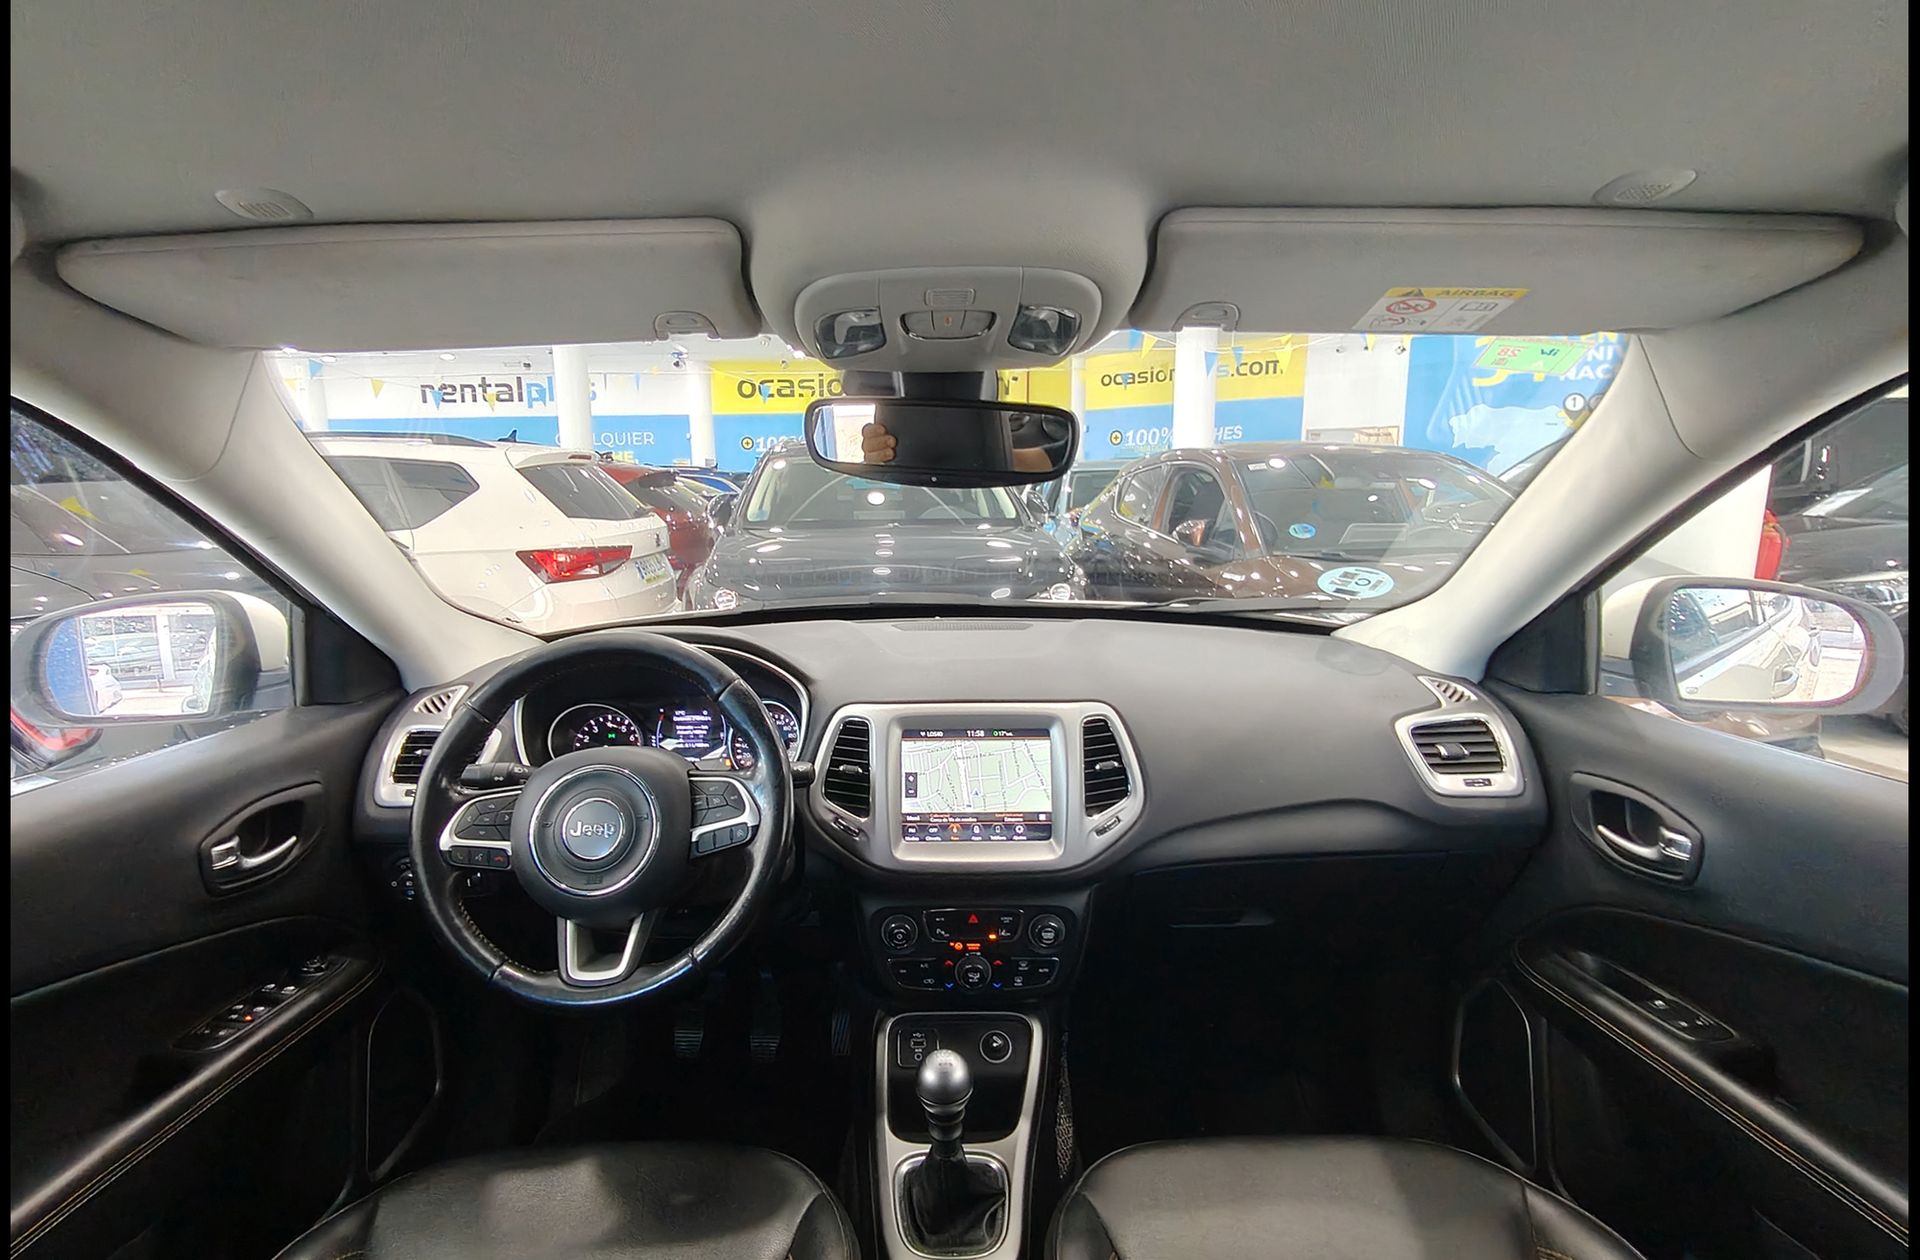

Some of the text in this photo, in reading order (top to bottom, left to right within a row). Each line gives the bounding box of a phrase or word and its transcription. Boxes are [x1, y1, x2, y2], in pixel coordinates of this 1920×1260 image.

[1437, 289, 1517, 297] AIRBAG
[420, 376, 596, 409] rentalpl
[737, 373, 844, 398] ocasio
[583, 735, 590, 743] 2
[569, 821, 617, 839] Jeep
